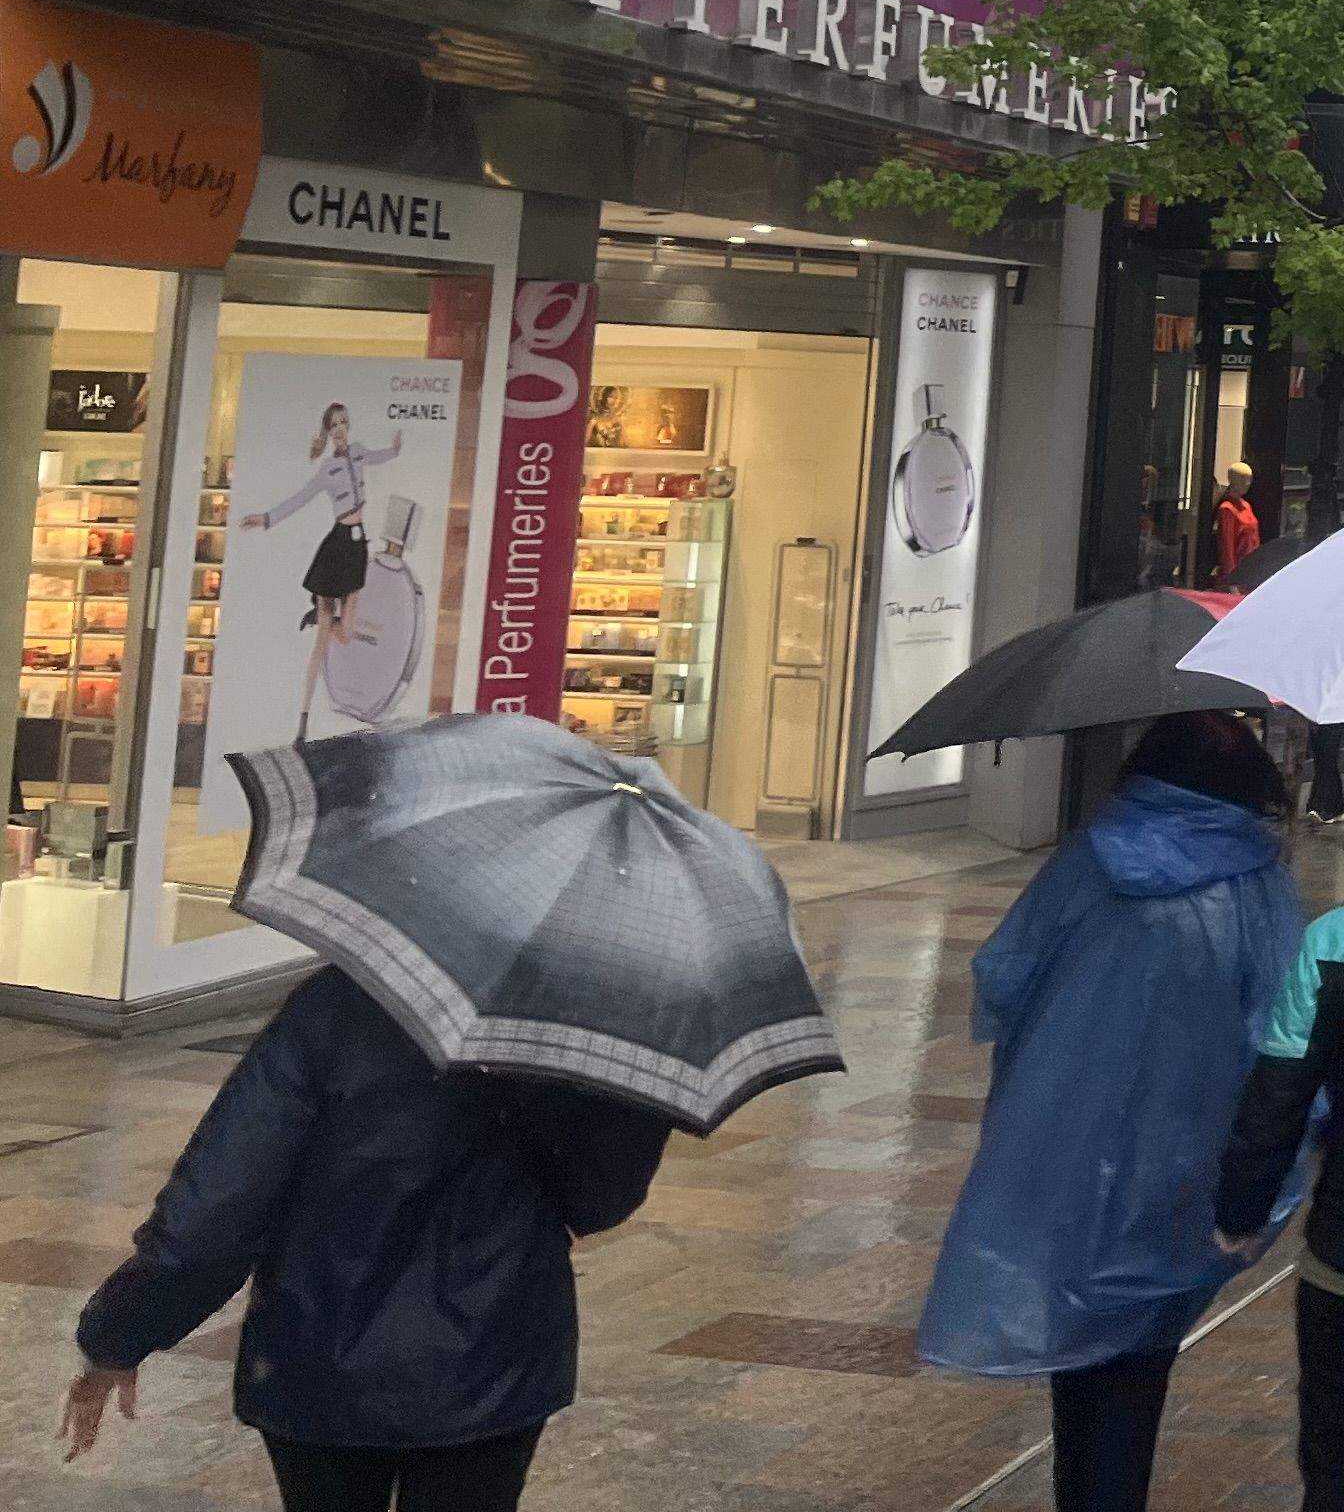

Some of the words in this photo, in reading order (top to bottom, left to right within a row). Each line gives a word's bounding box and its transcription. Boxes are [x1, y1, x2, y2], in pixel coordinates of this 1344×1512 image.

[287, 180, 451, 241] CHANEL
[918, 292, 979, 310] CHANCE
[916, 316, 977, 334] CHANEL
[390, 375, 451, 394] CHANCE
[386, 403, 448, 421] CHANEL
[483, 441, 554, 680] Perfumeries
